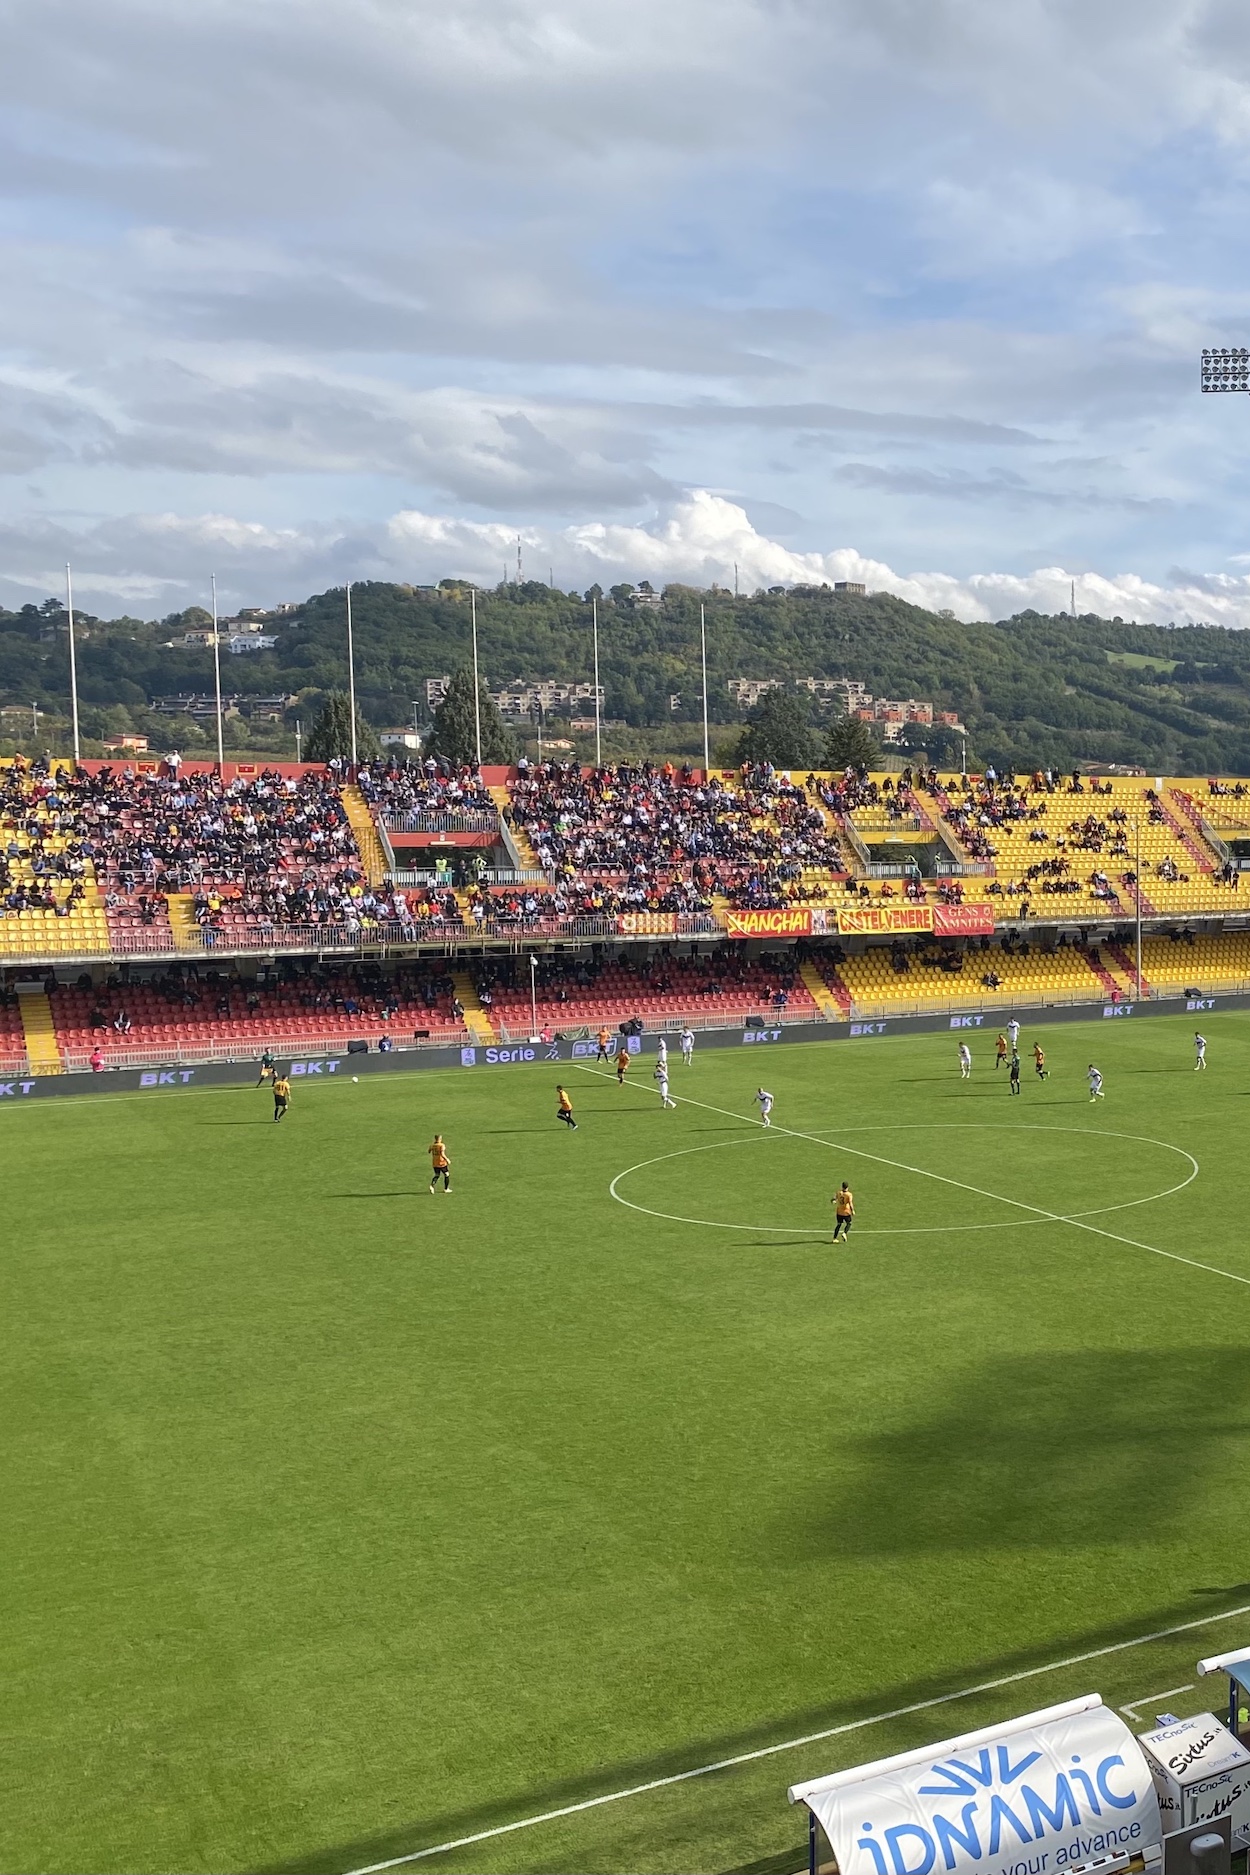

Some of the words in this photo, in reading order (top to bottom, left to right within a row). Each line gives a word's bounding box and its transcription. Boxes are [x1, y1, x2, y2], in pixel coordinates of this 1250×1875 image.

[948, 906, 979, 916] GENS
[728, 911, 808, 934] SHANGHAI
[1187, 999, 1215, 1010] BKT
[1103, 1005, 1134, 1018] BKT
[950, 1016, 984, 1028] BKT
[850, 1023, 887, 1036] BKT
[742, 1030, 782, 1043] BKT
[485, 1047, 535, 1064] Serie
[291, 1060, 341, 1076] BKT
[140, 1070, 195, 1087] BKT
[1056, 1822, 1141, 1865] advance
